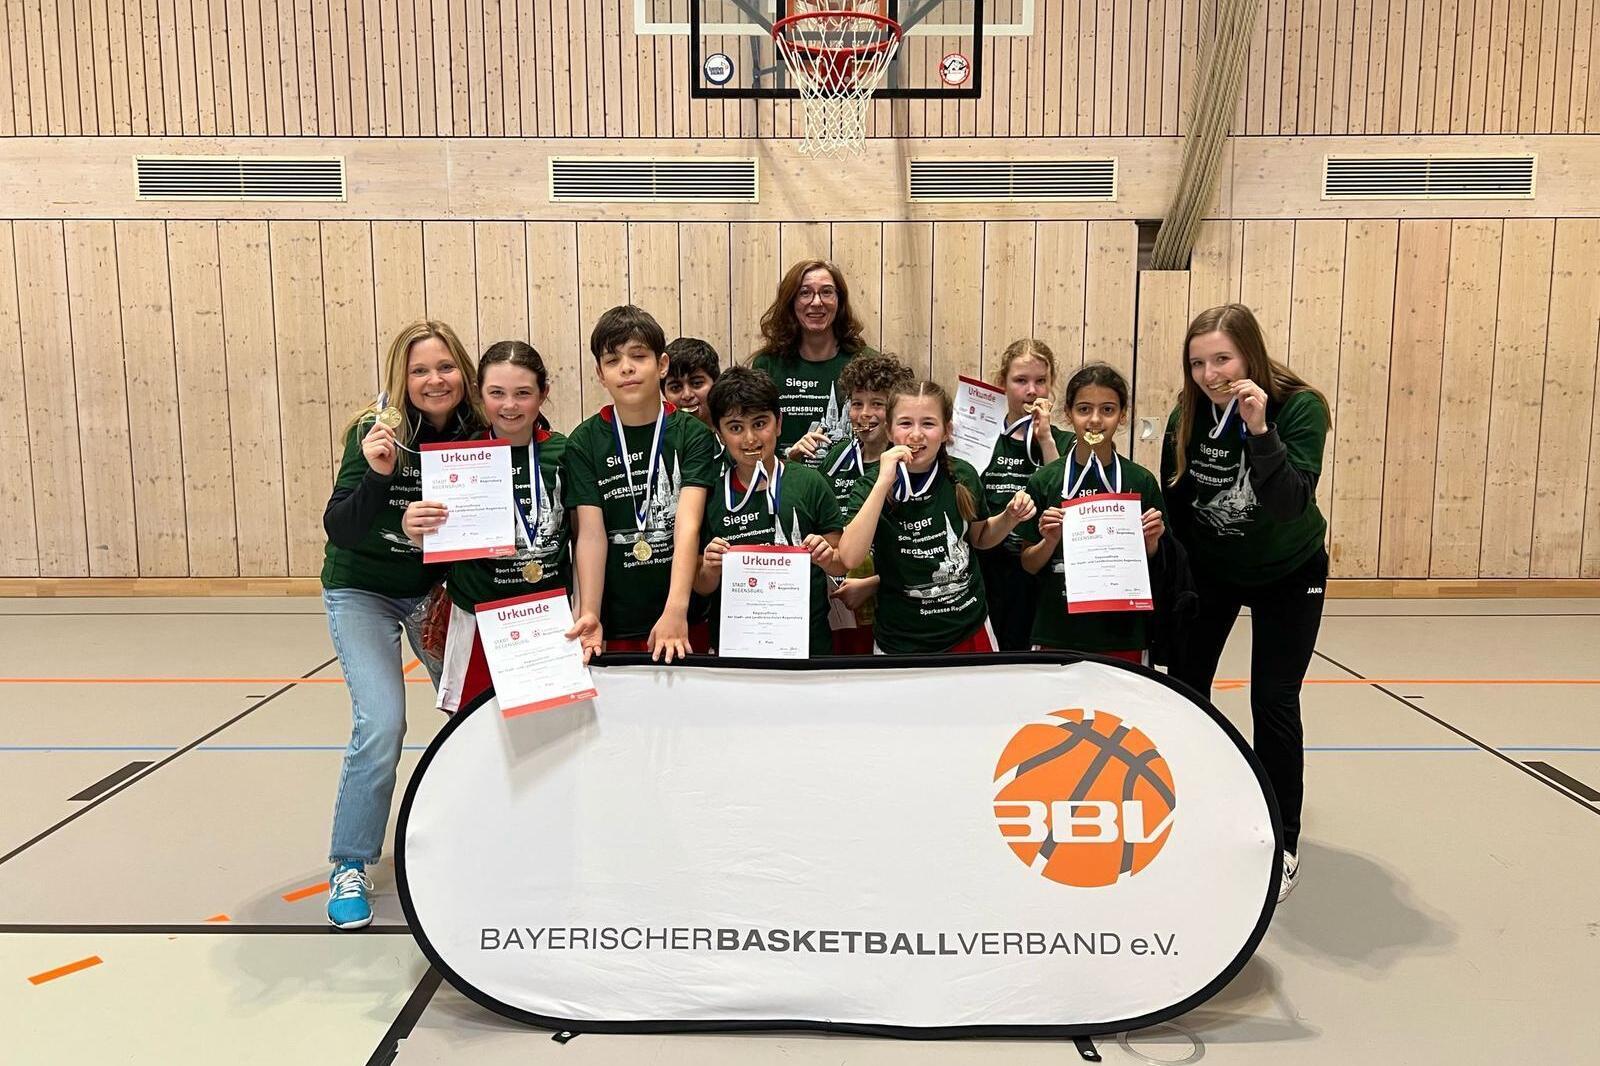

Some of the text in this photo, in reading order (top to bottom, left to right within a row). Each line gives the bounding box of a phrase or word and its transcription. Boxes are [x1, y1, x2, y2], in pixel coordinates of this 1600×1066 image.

[786, 377, 819, 389] Sieger
[969, 386, 997, 403] Urkunde
[441, 450, 492, 463] Urkunde
[1079, 503, 1125, 515] Urkunde
[723, 511, 760, 527] Sieger
[899, 517, 933, 531] ieger
[742, 554, 792, 568] Urkunde
[498, 603, 550, 621] Urkunde
[920, 607, 950, 616] Sparkasse
[993, 800, 1175, 844] BBV
[480, 926, 1180, 956] BAYERISCHERBASKETBALLVERBAND e.V.
